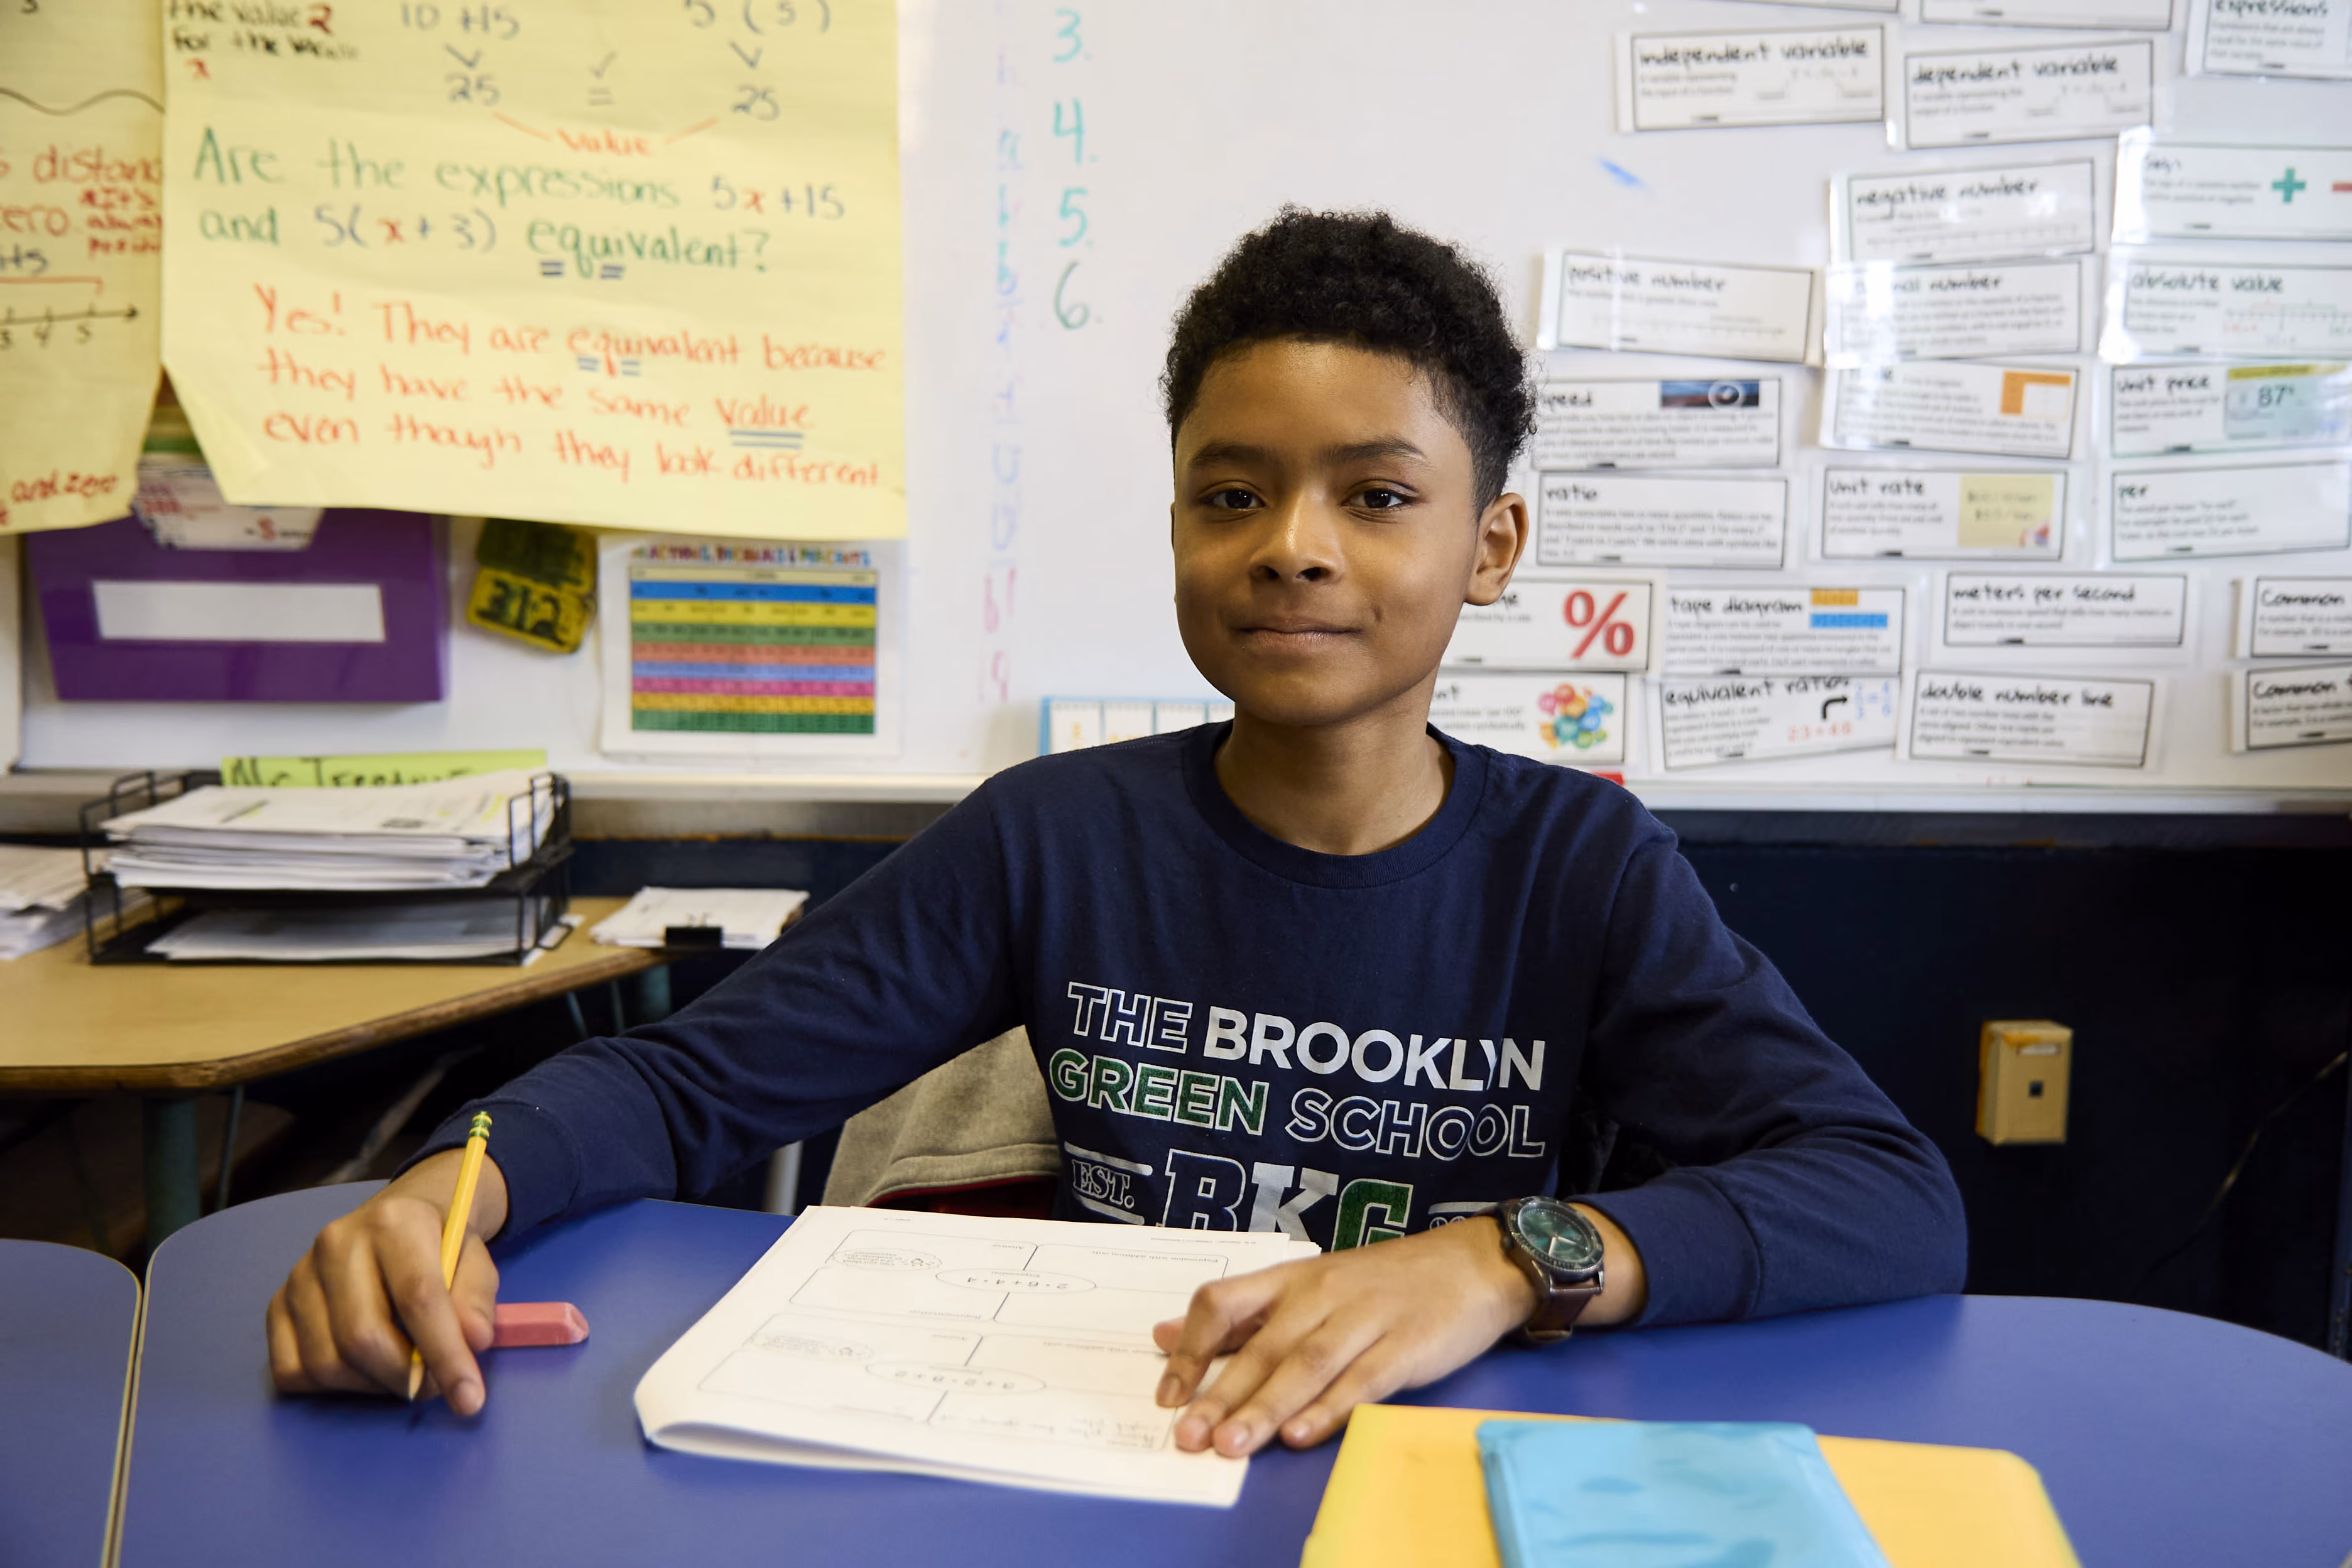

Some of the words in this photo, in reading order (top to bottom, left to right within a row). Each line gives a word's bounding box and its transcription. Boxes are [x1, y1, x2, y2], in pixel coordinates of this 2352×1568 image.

[1639, 43, 1772, 69] independent
[1782, 36, 1869, 61] variable
[1912, 60, 2021, 87] dependent
[2032, 53, 2118, 78] variable
[193, 127, 286, 185] Are
[315, 138, 405, 188] the
[435, 162, 682, 210] expressions
[1856, 179, 1946, 217] negative
[1959, 173, 2039, 201] number
[199, 206, 280, 246] and
[526, 219, 772, 280] equivalent?
[1650, 266, 1728, 292] number
[1929, 271, 2003, 292] number
[2130, 271, 2219, 295] absolute
[2230, 270, 2284, 293] value
[253, 283, 347, 337] Yes!
[371, 300, 471, 355] They
[490, 324, 552, 354] are
[567, 328, 741, 377] equivalent
[763, 333, 886, 372] because
[256, 347, 356, 401] they
[380, 362, 470, 402] have
[493, 377, 564, 410] the
[588, 387, 691, 428] same
[715, 395, 815, 428] value
[263, 412, 360, 445] even
[553, 430, 631, 484] they
[656, 442, 719, 477] look
[733, 452, 881, 489] different
[1545, 485, 1599, 501] ratio
[1880, 478, 1925, 497] rate
[2118, 486, 2147, 501] per
[1671, 596, 1714, 618] tape
[1723, 596, 1804, 617] diagram
[1952, 584, 2024, 599] meters
[2033, 585, 2064, 604] per
[2072, 584, 2135, 600] second
[2261, 588, 2346, 607] Common
[1563, 589, 1635, 660] %
[1665, 678, 1773, 706] equivalent
[1921, 683, 1982, 700] double
[1995, 685, 2072, 705] number
[2253, 678, 2338, 700] Common
[1068, 981, 1192, 1054] THE
[1050, 1047, 1269, 1136] GREEN
[1285, 1087, 1545, 1162] SCHOOL
[1071, 1158, 1135, 1209] EST.
[1156, 1148, 1415, 1254] BKG
